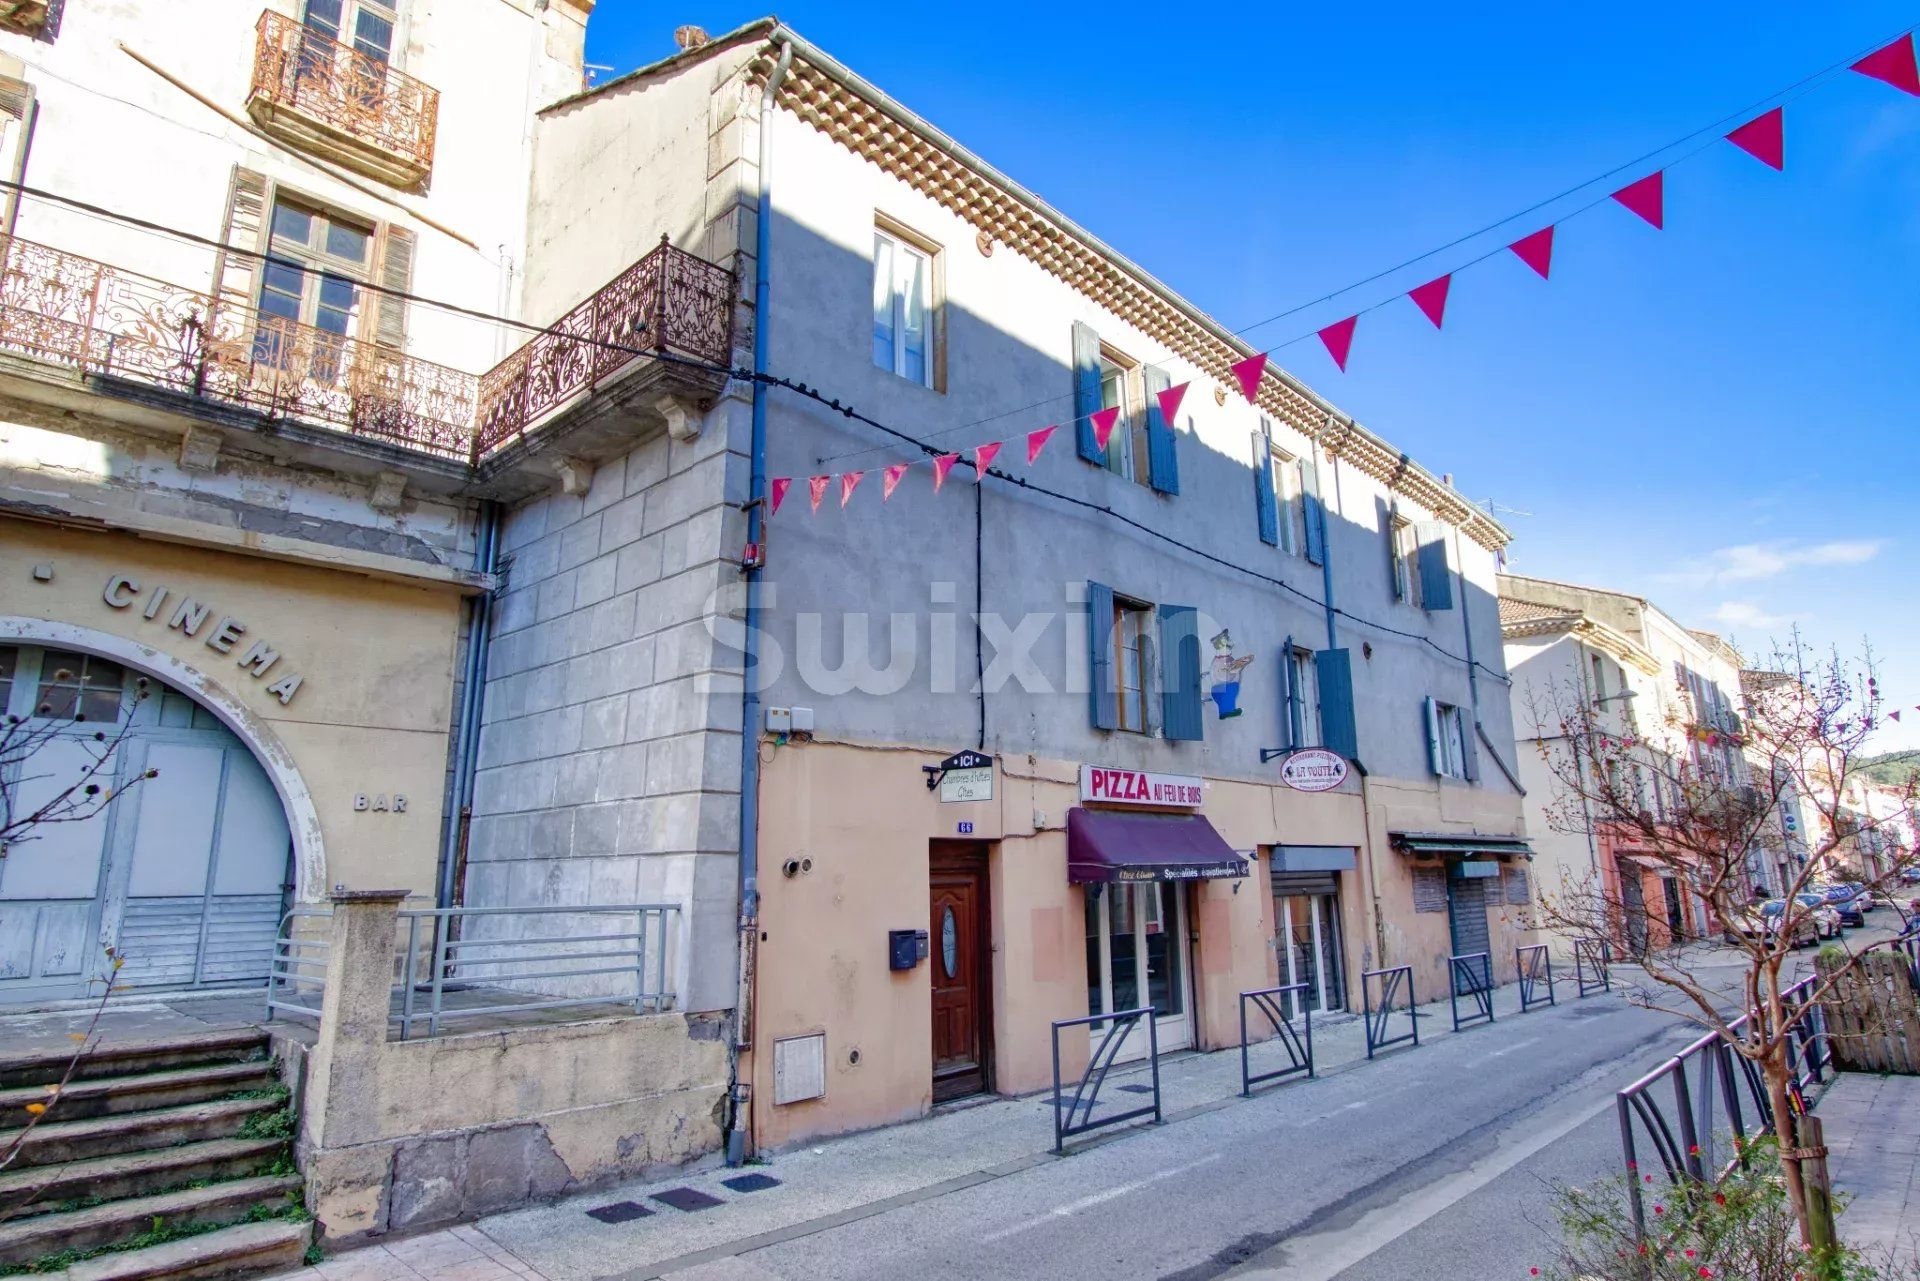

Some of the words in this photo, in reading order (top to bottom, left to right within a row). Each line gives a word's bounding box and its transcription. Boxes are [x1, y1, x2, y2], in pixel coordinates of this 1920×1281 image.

[103, 573, 304, 705] CINEMA
[960, 755, 973, 767] ICI
[1091, 769, 1150, 801] PIZZA
[1154, 783, 1163, 801] AU
[1164, 784, 1176, 802] FEU
[1177, 785, 1187, 803] DE
[1187, 786, 1202, 804] BOIS
[354, 792, 408, 813] BAR
[960, 823, 972, 833] 66
